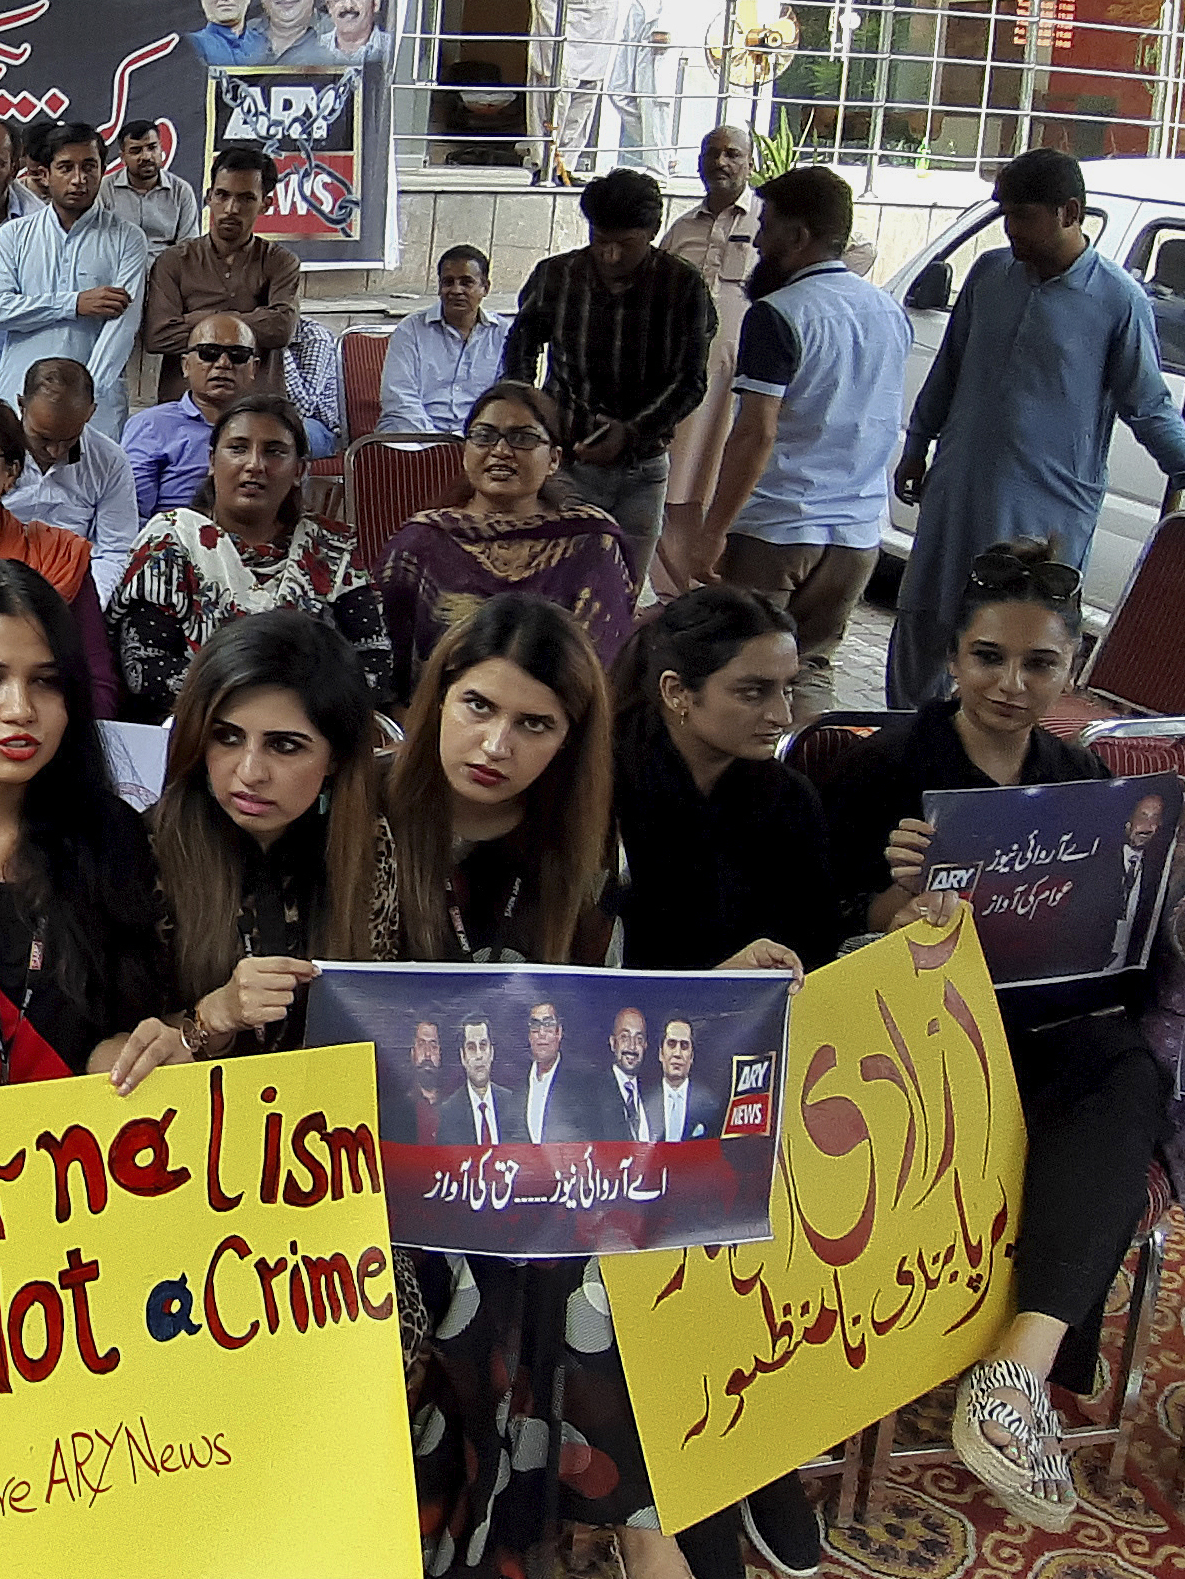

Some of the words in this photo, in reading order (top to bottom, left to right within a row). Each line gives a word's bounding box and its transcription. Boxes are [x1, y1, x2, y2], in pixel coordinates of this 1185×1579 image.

[985, 842, 1019, 874] نیوز
[1062, 836, 1101, 862] اے
[930, 868, 976, 891] ARY
[981, 883, 1028, 916] آواز
[737, 1061, 770, 1092] ARY
[731, 1103, 762, 1126] NEWS
[423, 1156, 471, 1202] آواز
[469, 1147, 493, 1210] کی
[491, 1159, 520, 1210] حق
[549, 1162, 578, 1209] نیوز
[579, 1145, 610, 1209] وائی
[626, 1167, 667, 1201] اے
[870, 1166, 983, 1337] پابندی
[146, 1272, 203, 1342] a
[204, 1234, 394, 1351] Crime
